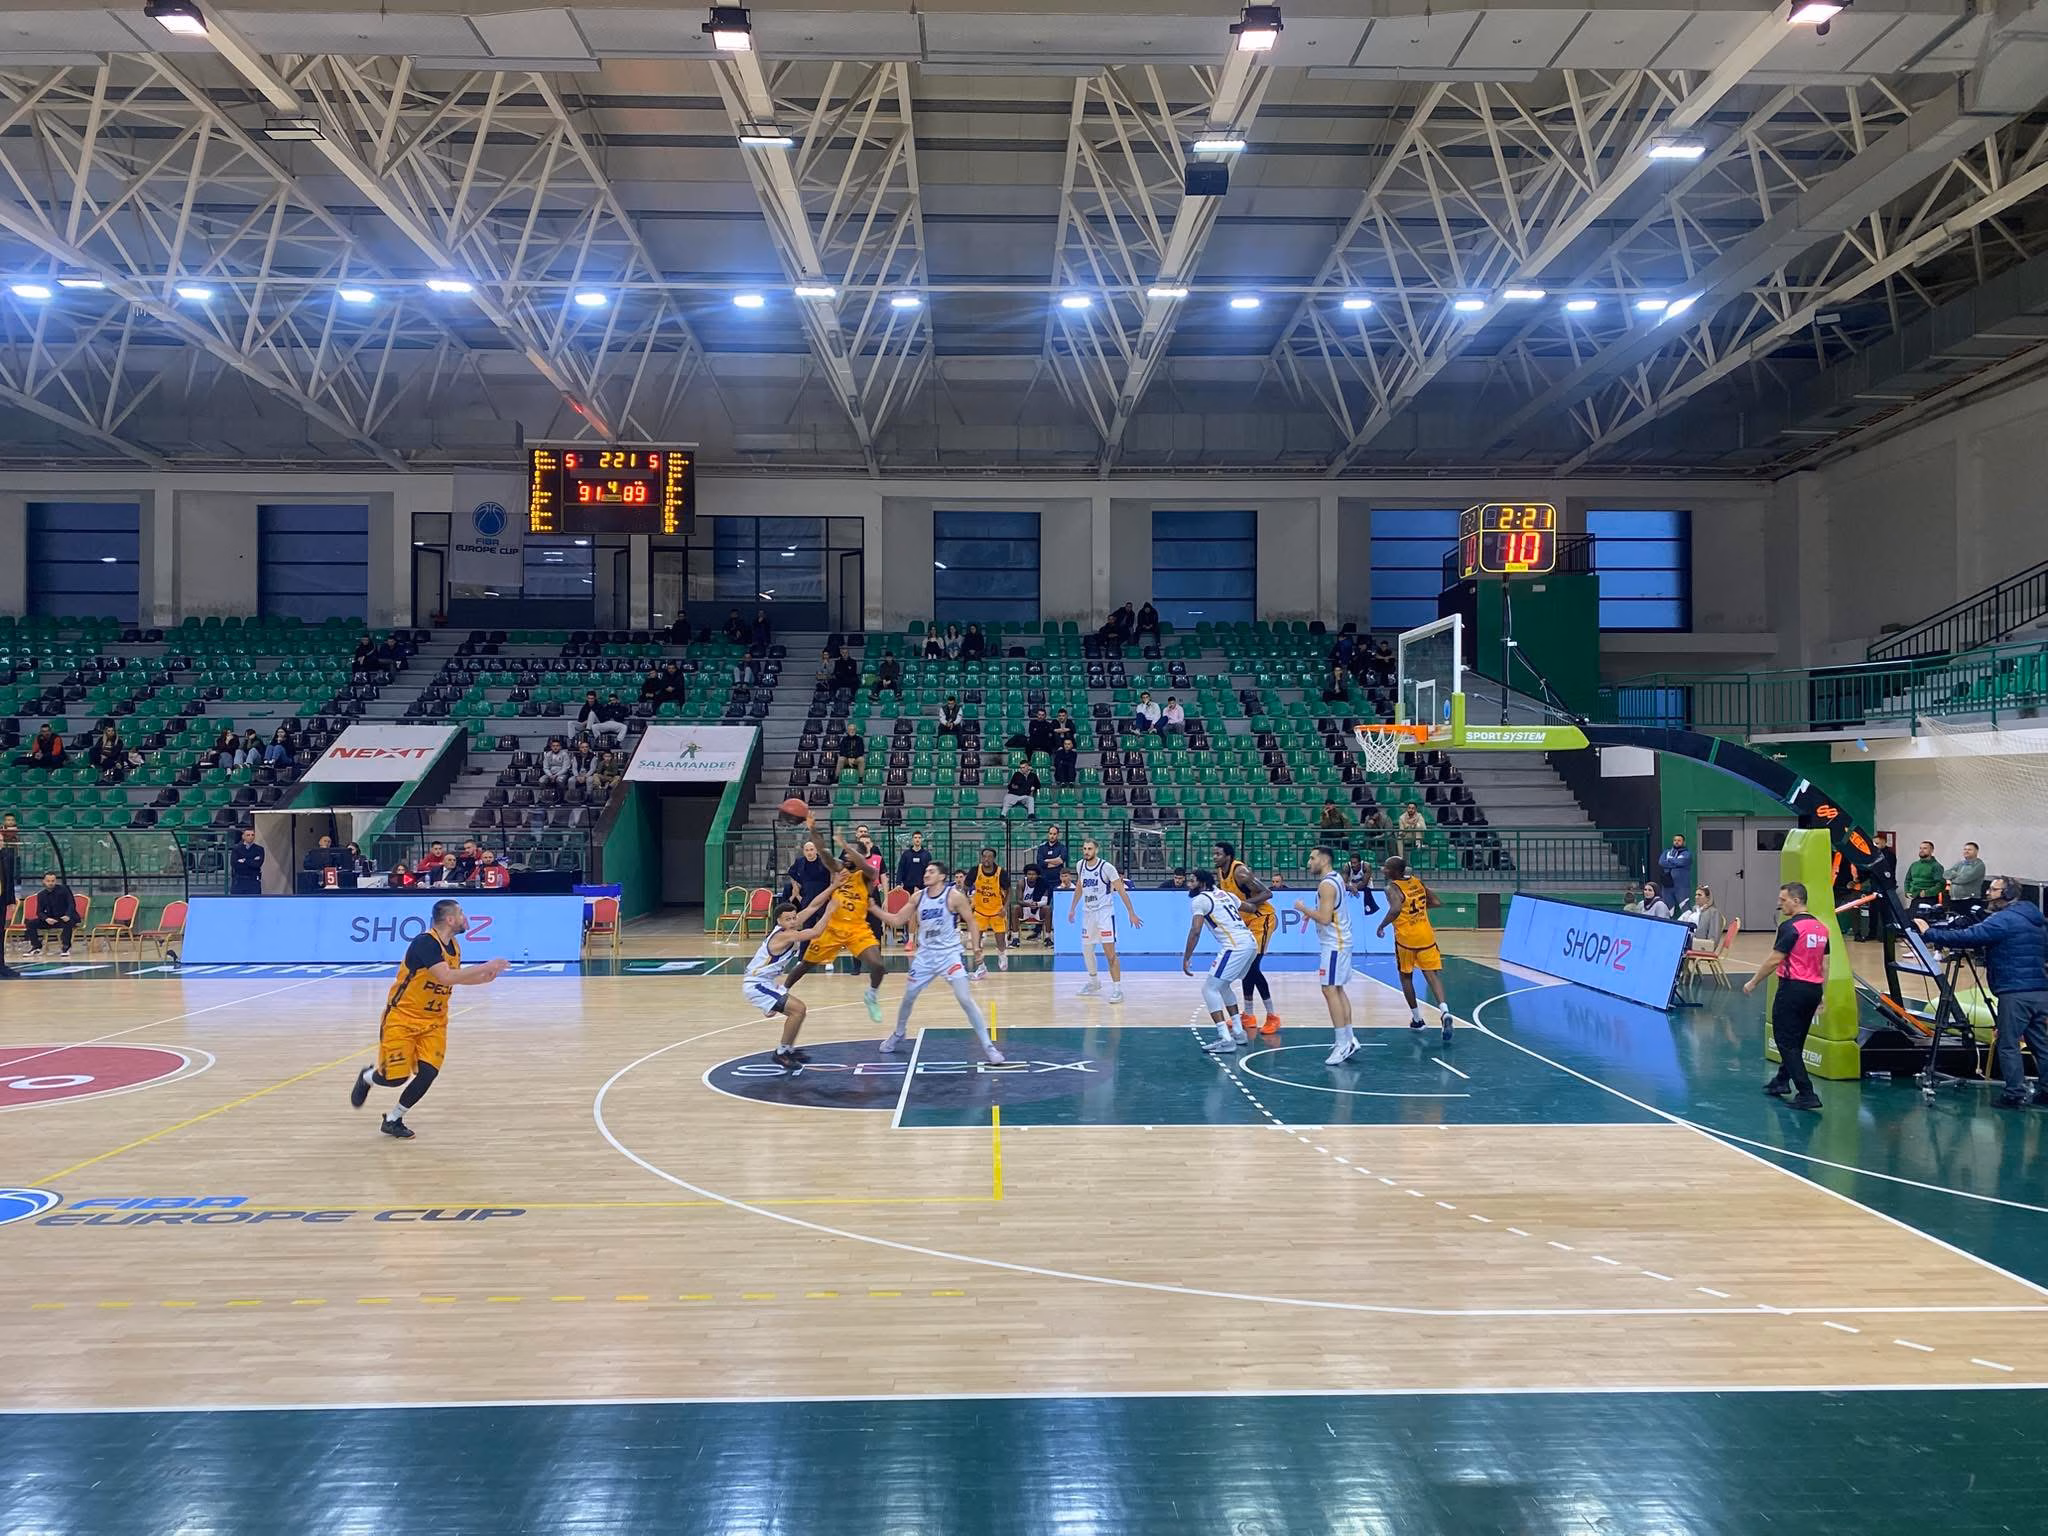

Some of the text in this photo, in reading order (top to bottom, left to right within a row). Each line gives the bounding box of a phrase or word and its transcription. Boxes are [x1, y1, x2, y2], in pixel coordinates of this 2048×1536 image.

[565, 454, 575, 467] 5
[649, 455, 658, 468] 5
[580, 485, 645, 502] 91 89
[607, 481, 617, 493] 4
[1500, 508, 1552, 529] 2:21
[476, 537, 499, 545] FIBA
[1508, 532, 1540, 563] 10
[456, 544, 496, 554] EUROPE
[639, 760, 736, 769] SALAMANDER
[327, 871, 335, 884] 5
[487, 870, 496, 883] 5
[69, 1196, 249, 1210] FIBA
[34, 1208, 526, 1227] EUROPE CUP
